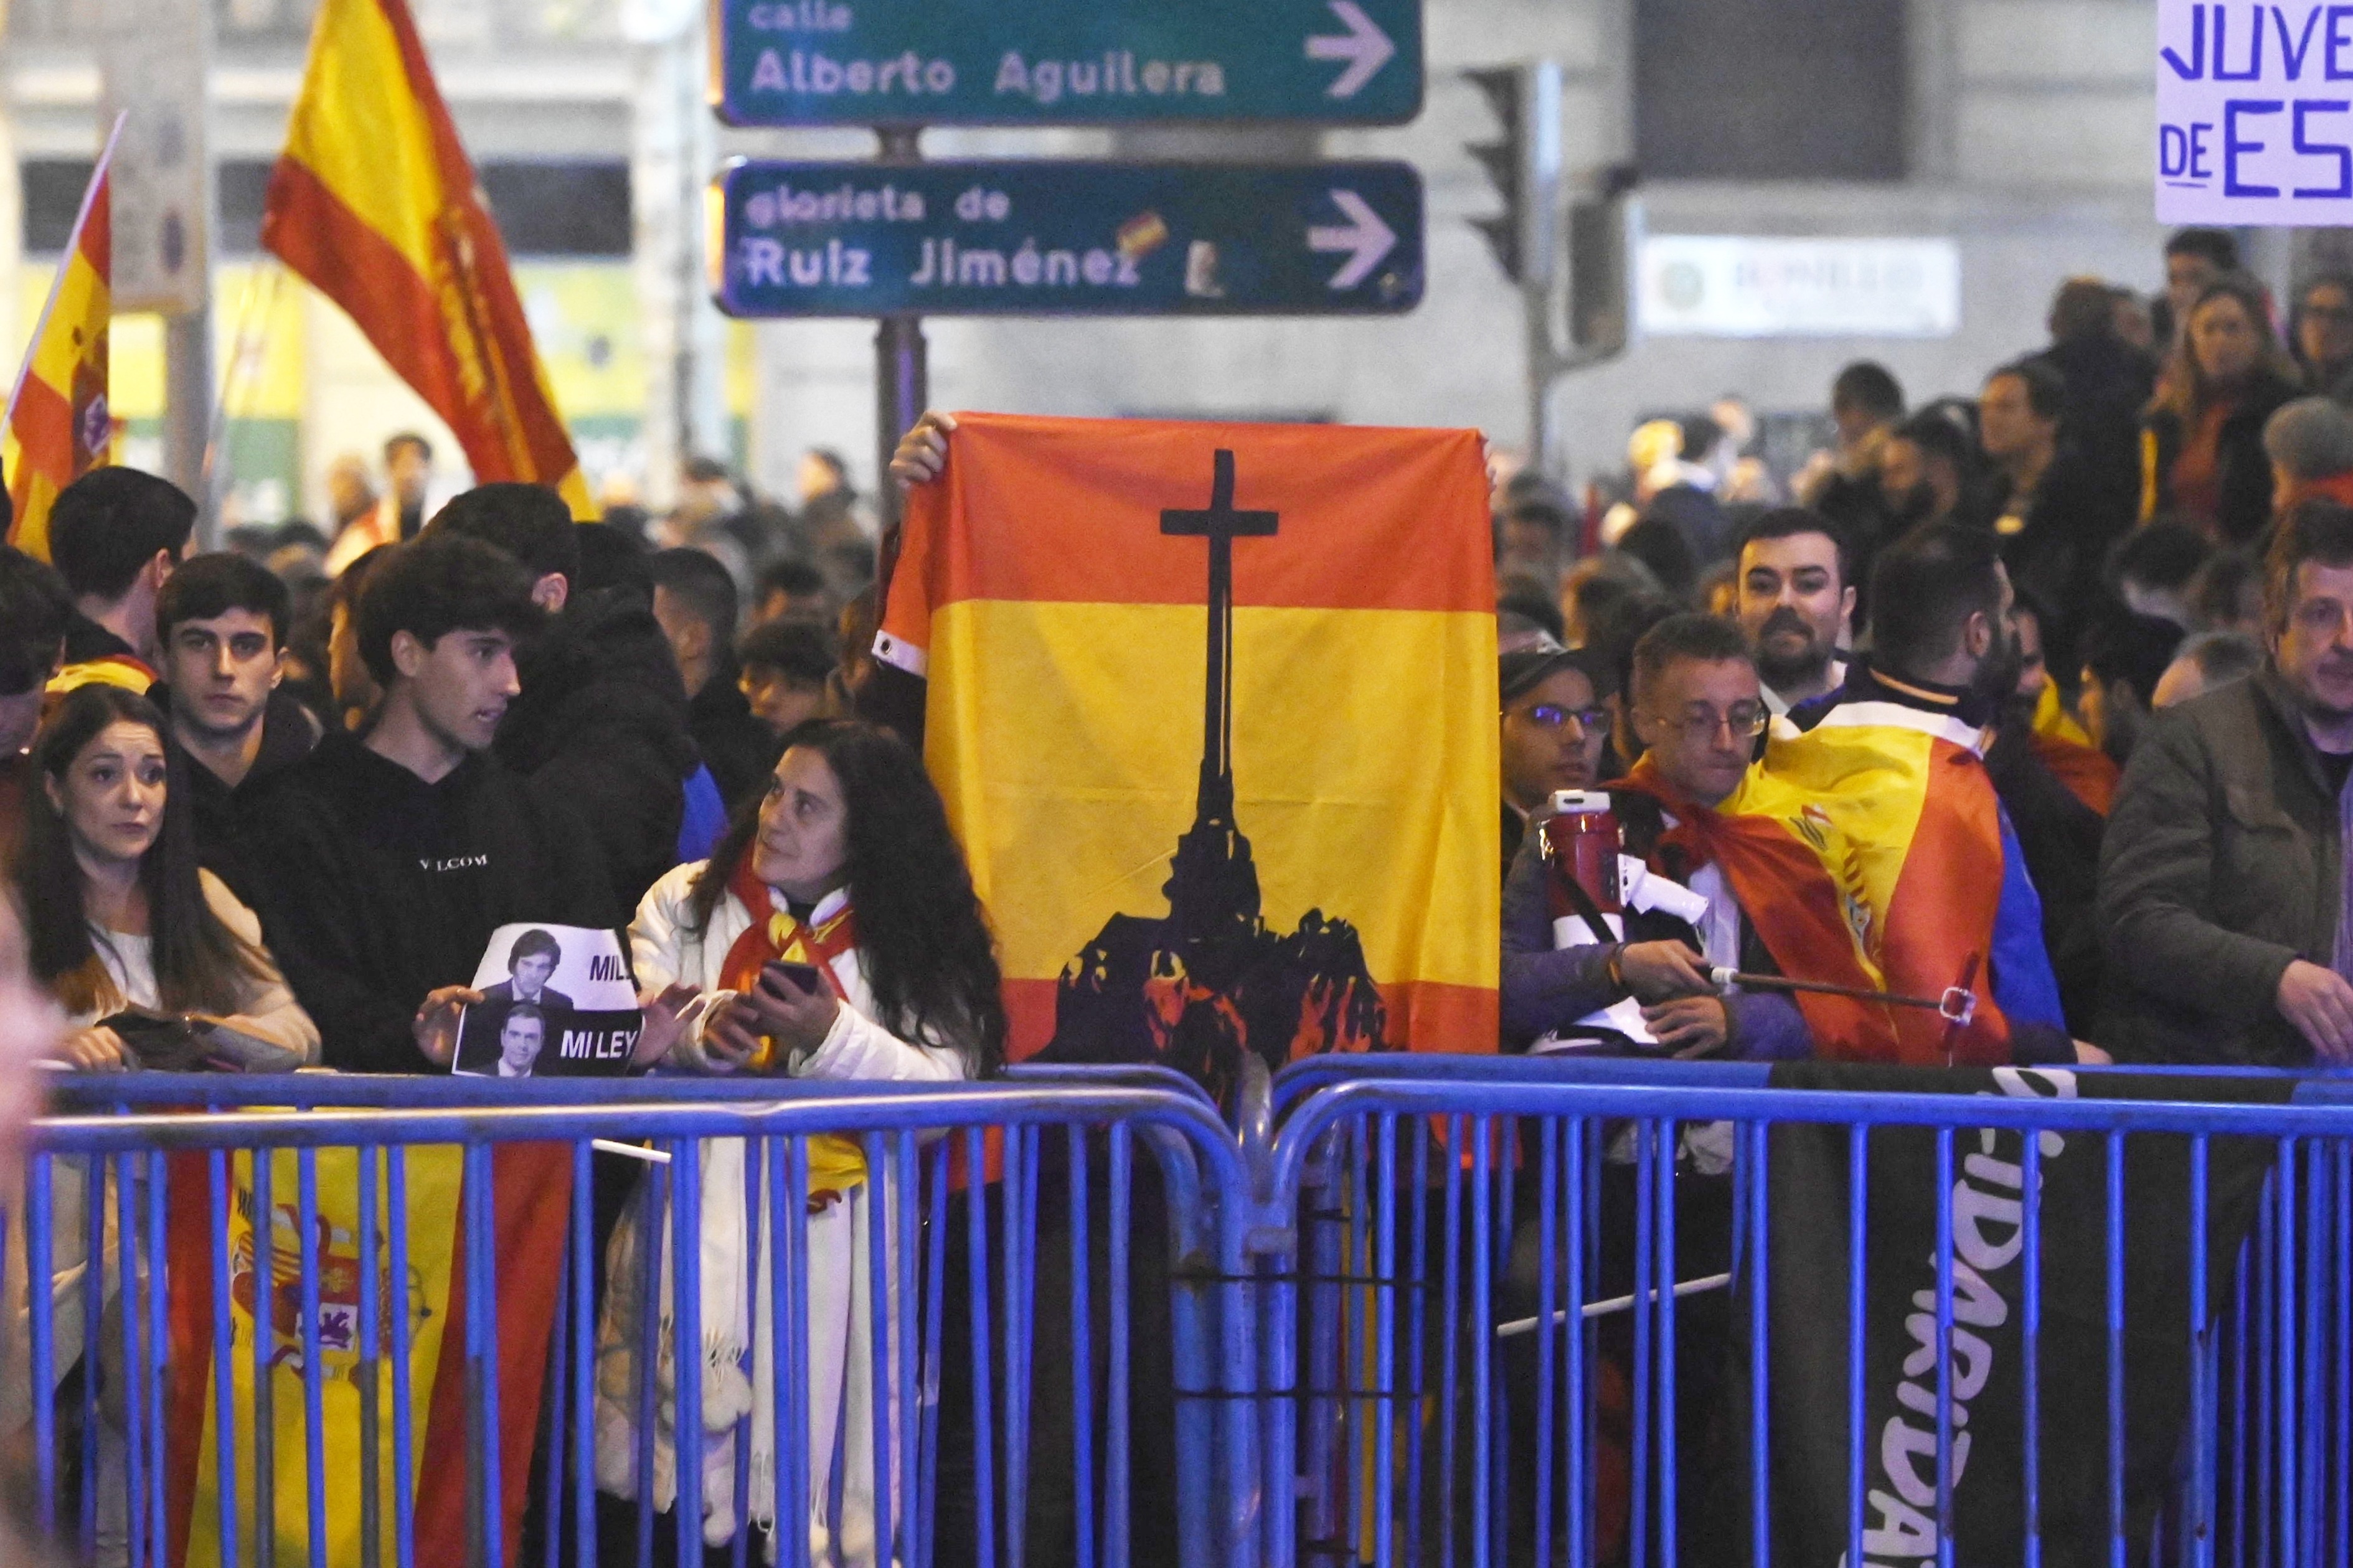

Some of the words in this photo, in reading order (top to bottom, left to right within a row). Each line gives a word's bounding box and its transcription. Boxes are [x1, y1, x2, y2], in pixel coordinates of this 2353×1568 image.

[748, 0, 852, 30] calle
[750, 47, 956, 94] Alberto
[994, 49, 1224, 103] Aguilera
[2160, 123, 2214, 178] DE
[2224, 99, 2353, 199] ES
[746, 185, 926, 228] glorieta
[955, 186, 1009, 221] de
[745, 238, 871, 286] Ruiz
[910, 237, 1141, 286] Jiménez
[589, 955, 630, 982] MIL
